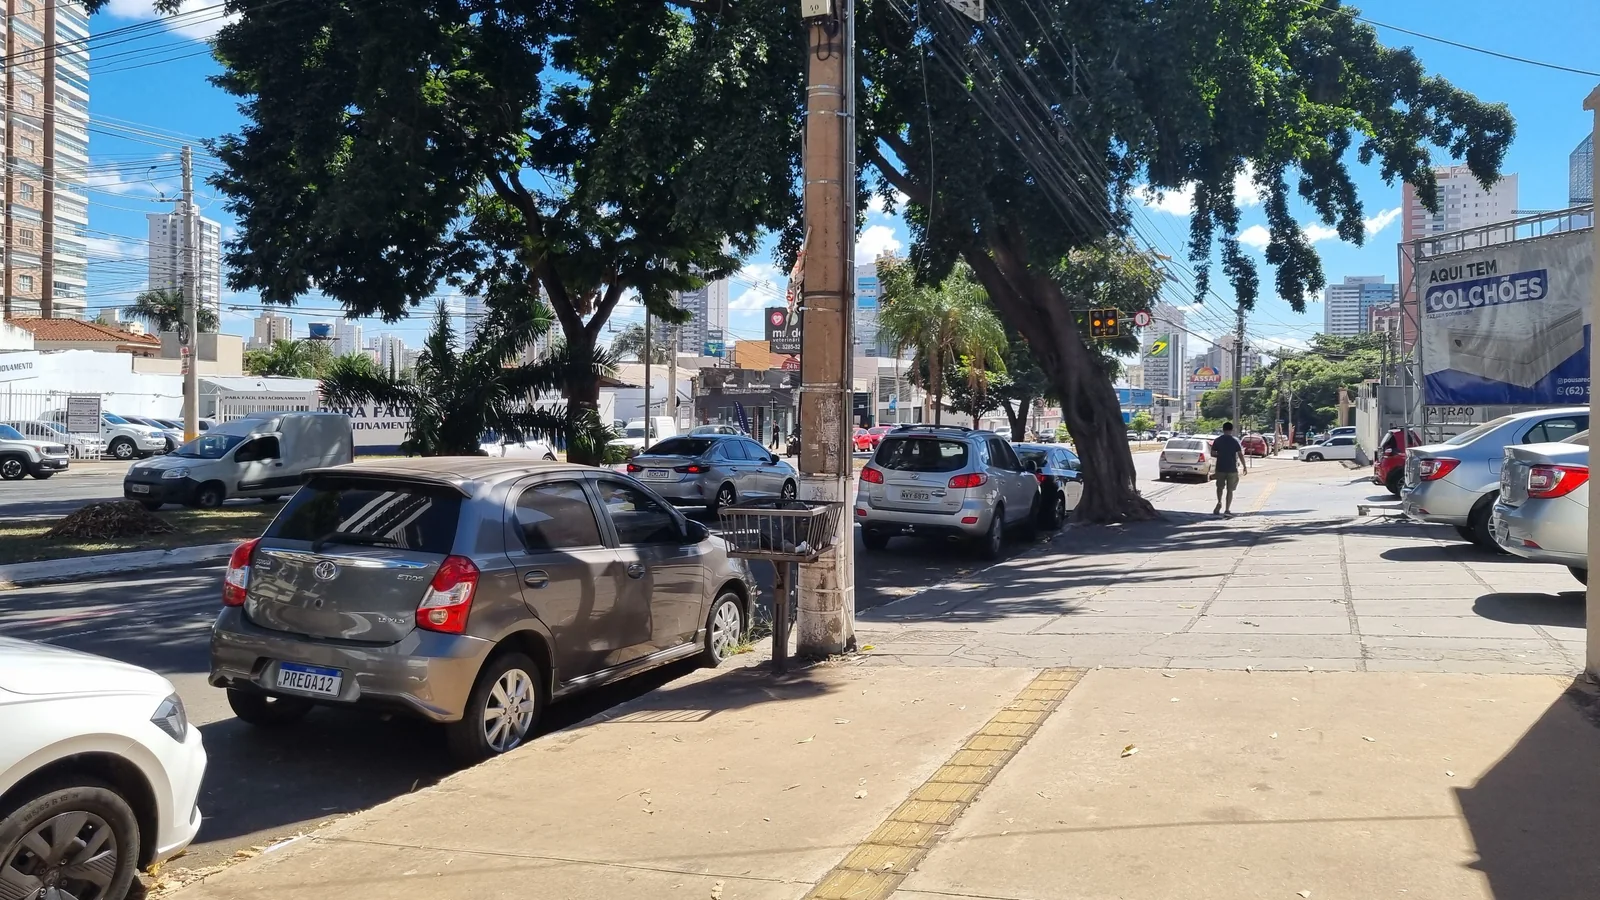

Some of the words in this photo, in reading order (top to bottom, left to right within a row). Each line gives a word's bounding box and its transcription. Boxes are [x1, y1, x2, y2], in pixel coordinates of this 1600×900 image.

[1429, 265, 1463, 284] AQUI
[1467, 259, 1498, 277] TEM
[1430, 276, 1543, 311] COLCHÕES
[1565, 386, 1584, 396] (62)
